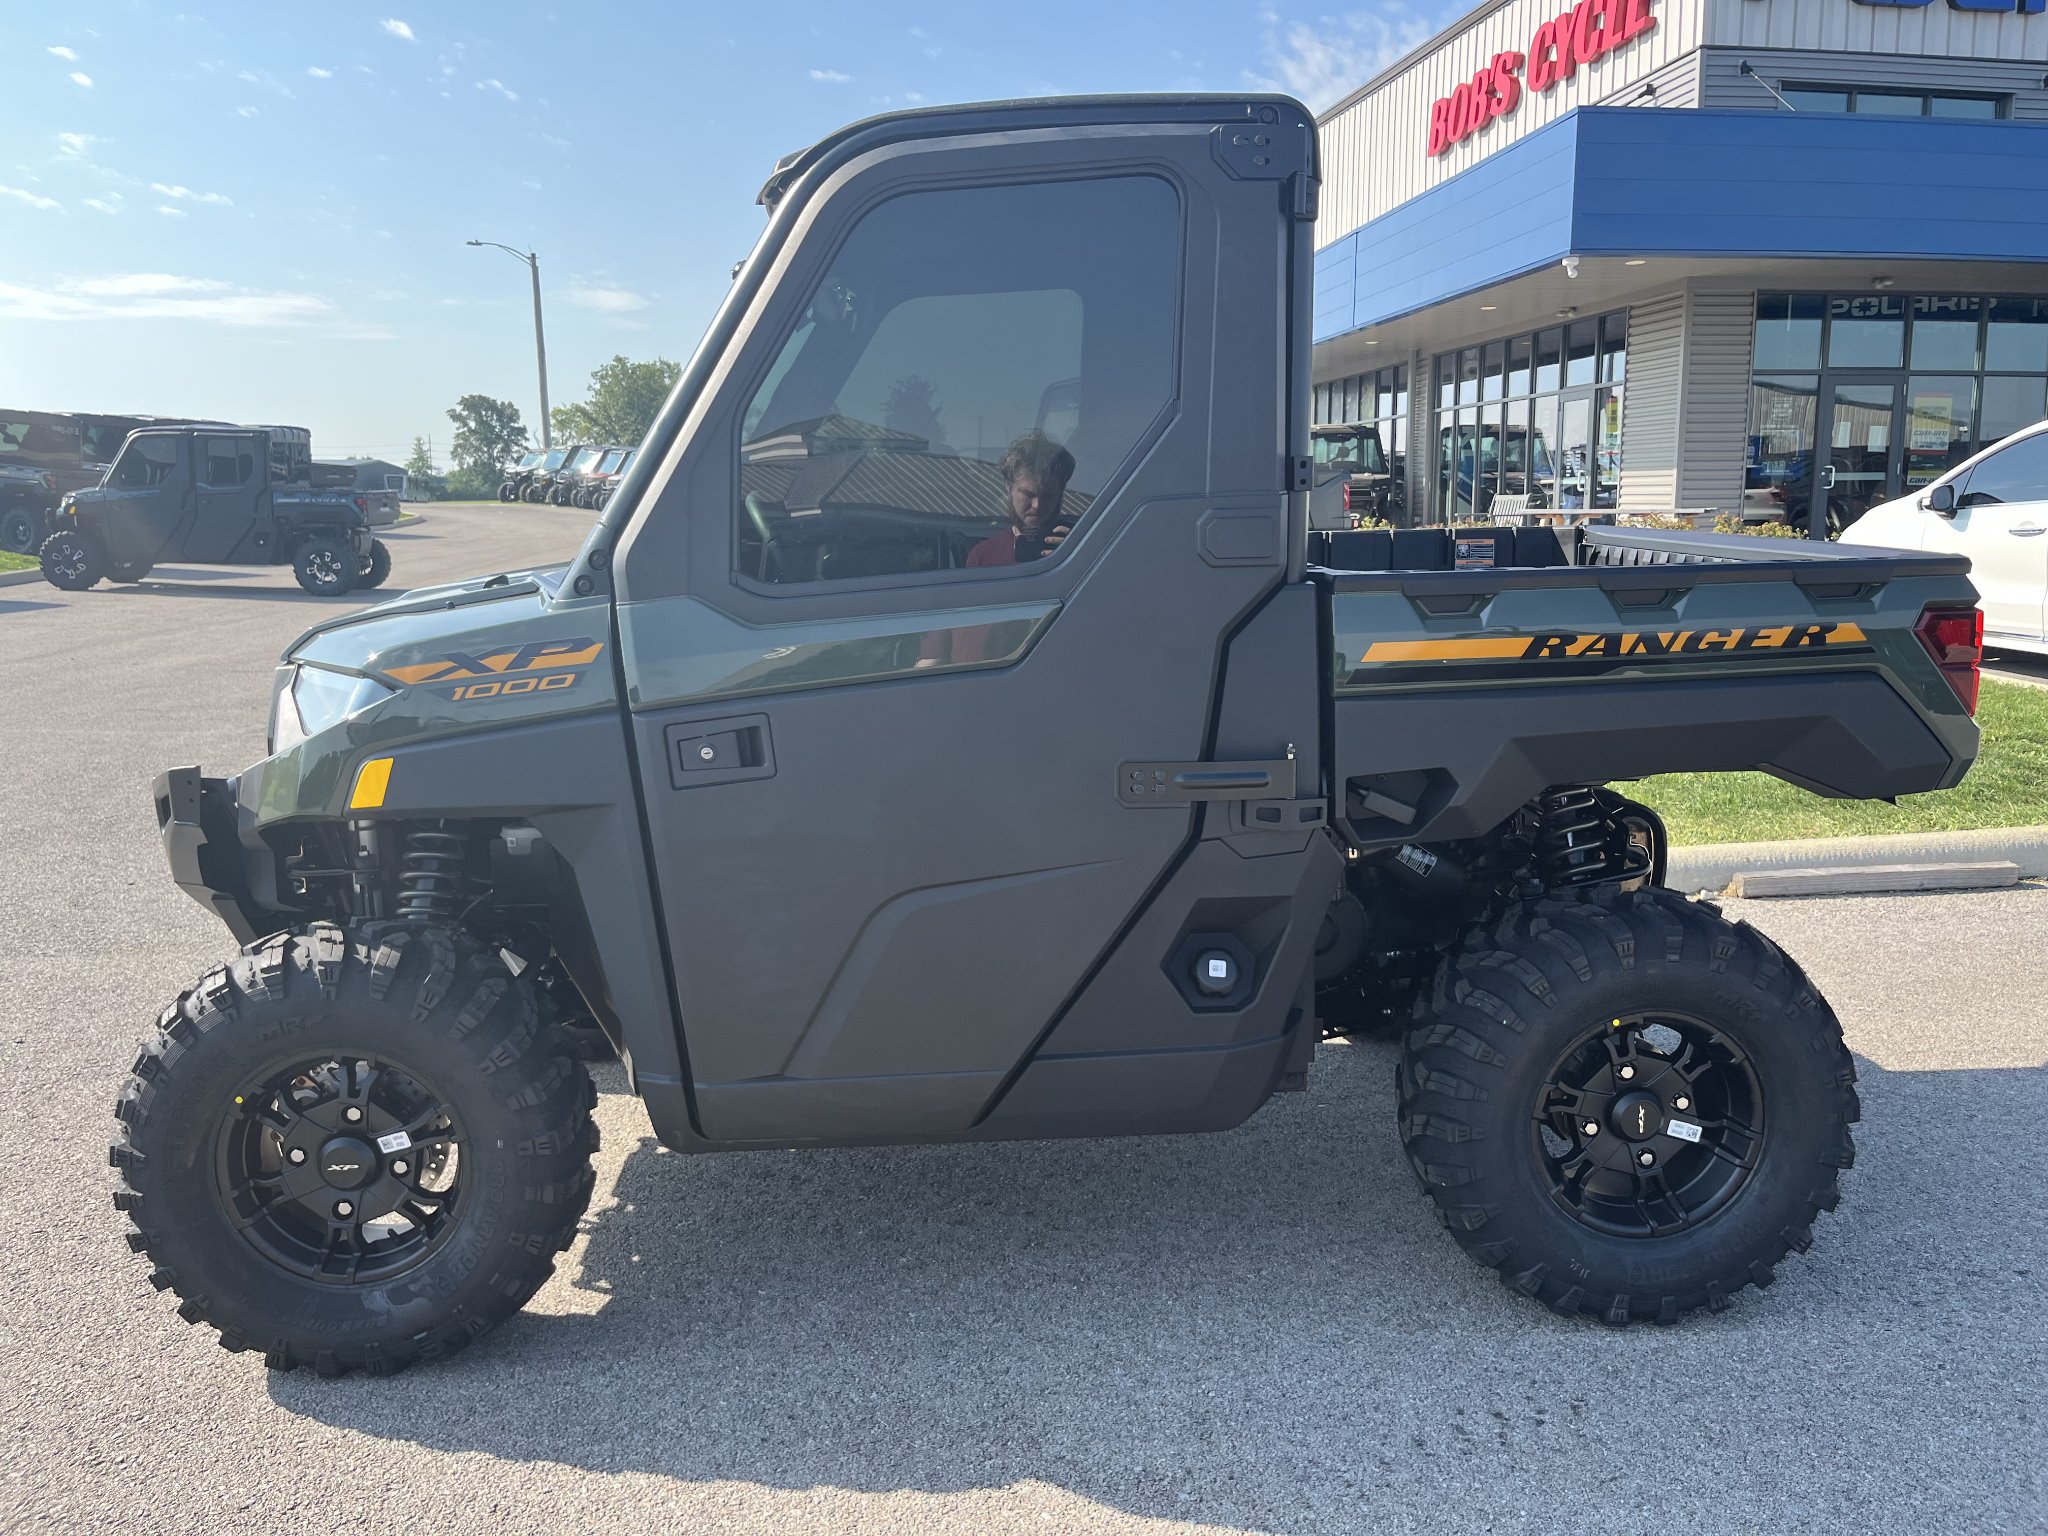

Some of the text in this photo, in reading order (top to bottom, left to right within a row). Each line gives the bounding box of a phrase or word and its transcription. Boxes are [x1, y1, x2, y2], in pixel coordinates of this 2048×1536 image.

[1428, 50, 1525, 157] BOB'S
[415, 635, 598, 683] XP
[1520, 621, 1838, 660] RANGER
[452, 673, 577, 701] 1000
